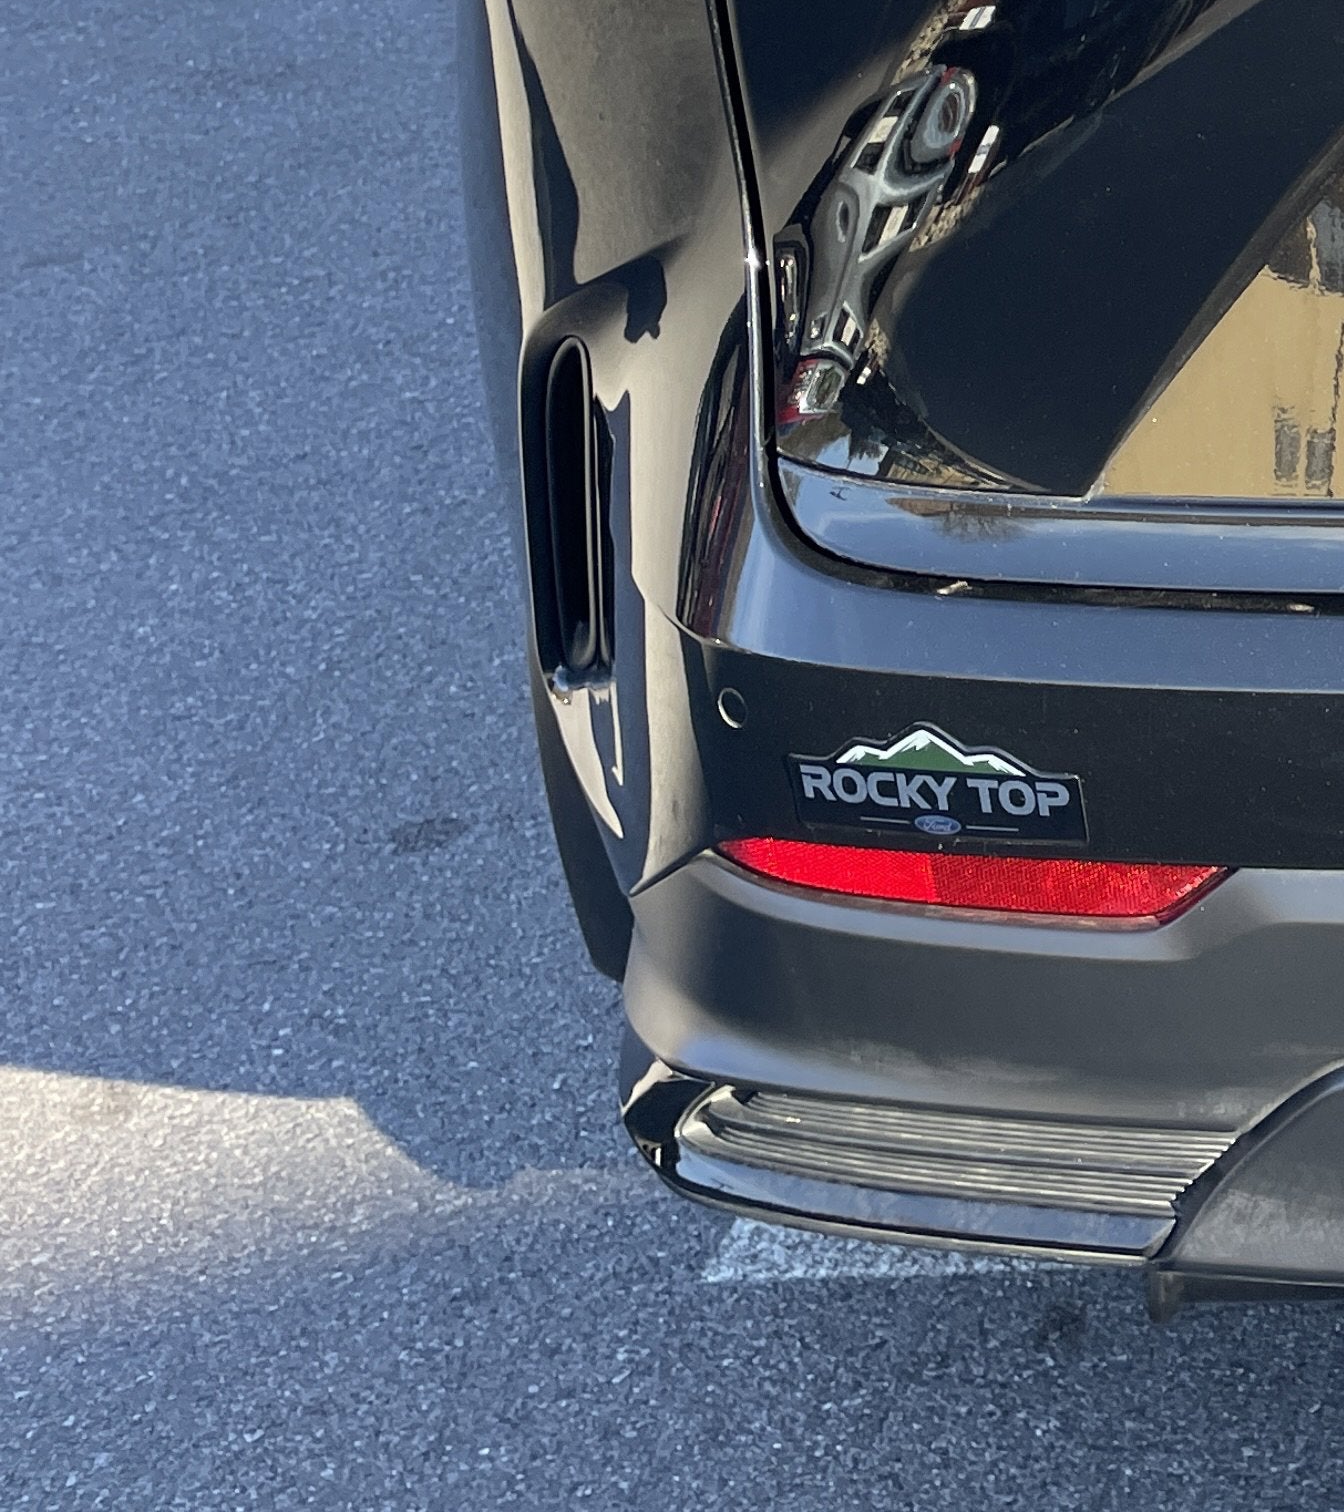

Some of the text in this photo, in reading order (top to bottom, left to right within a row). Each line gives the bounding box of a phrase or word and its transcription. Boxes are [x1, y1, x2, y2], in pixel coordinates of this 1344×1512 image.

[799, 764, 1070, 818] ROCKY TOP
[923, 817, 954, 832] Ford
